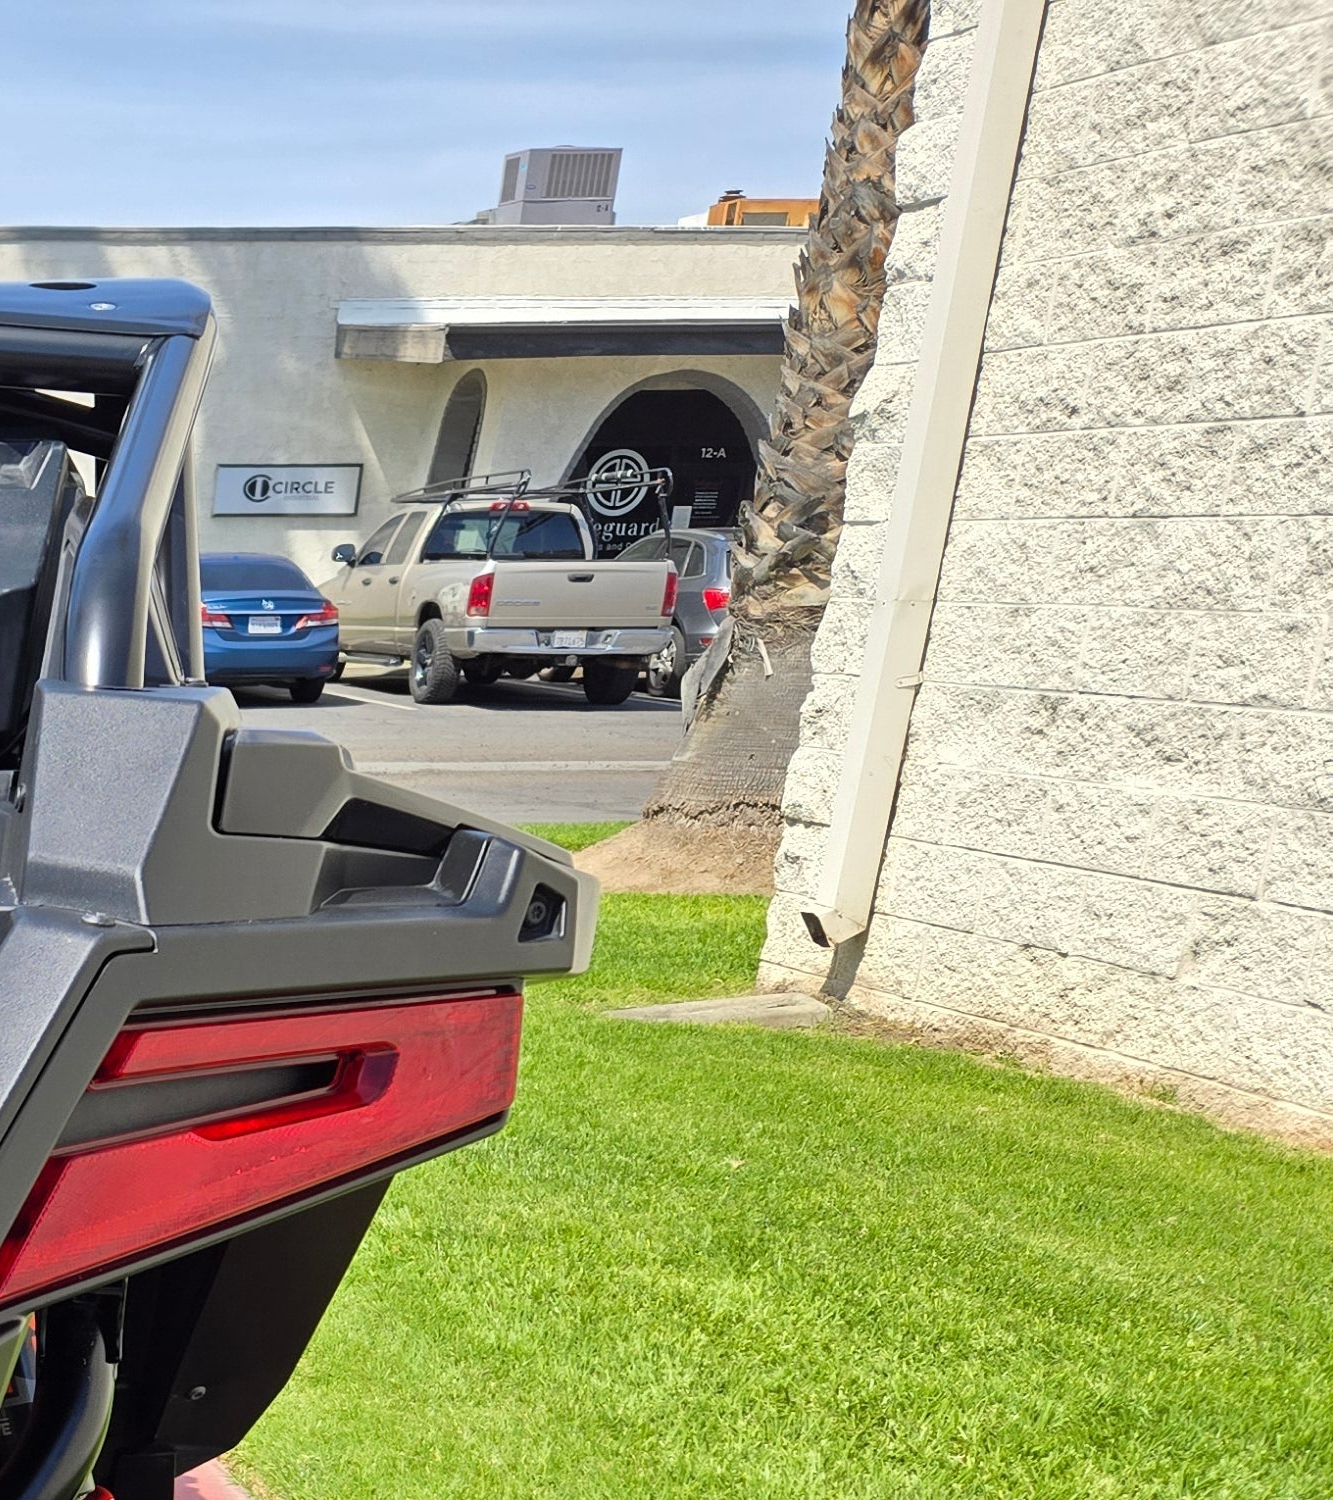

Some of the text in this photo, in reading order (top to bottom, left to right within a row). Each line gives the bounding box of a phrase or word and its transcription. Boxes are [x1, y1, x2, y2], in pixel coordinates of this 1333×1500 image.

[700, 447, 727, 459] 12-A
[272, 481, 335, 494] CIRCLE
[593, 517, 660, 541] eguard
